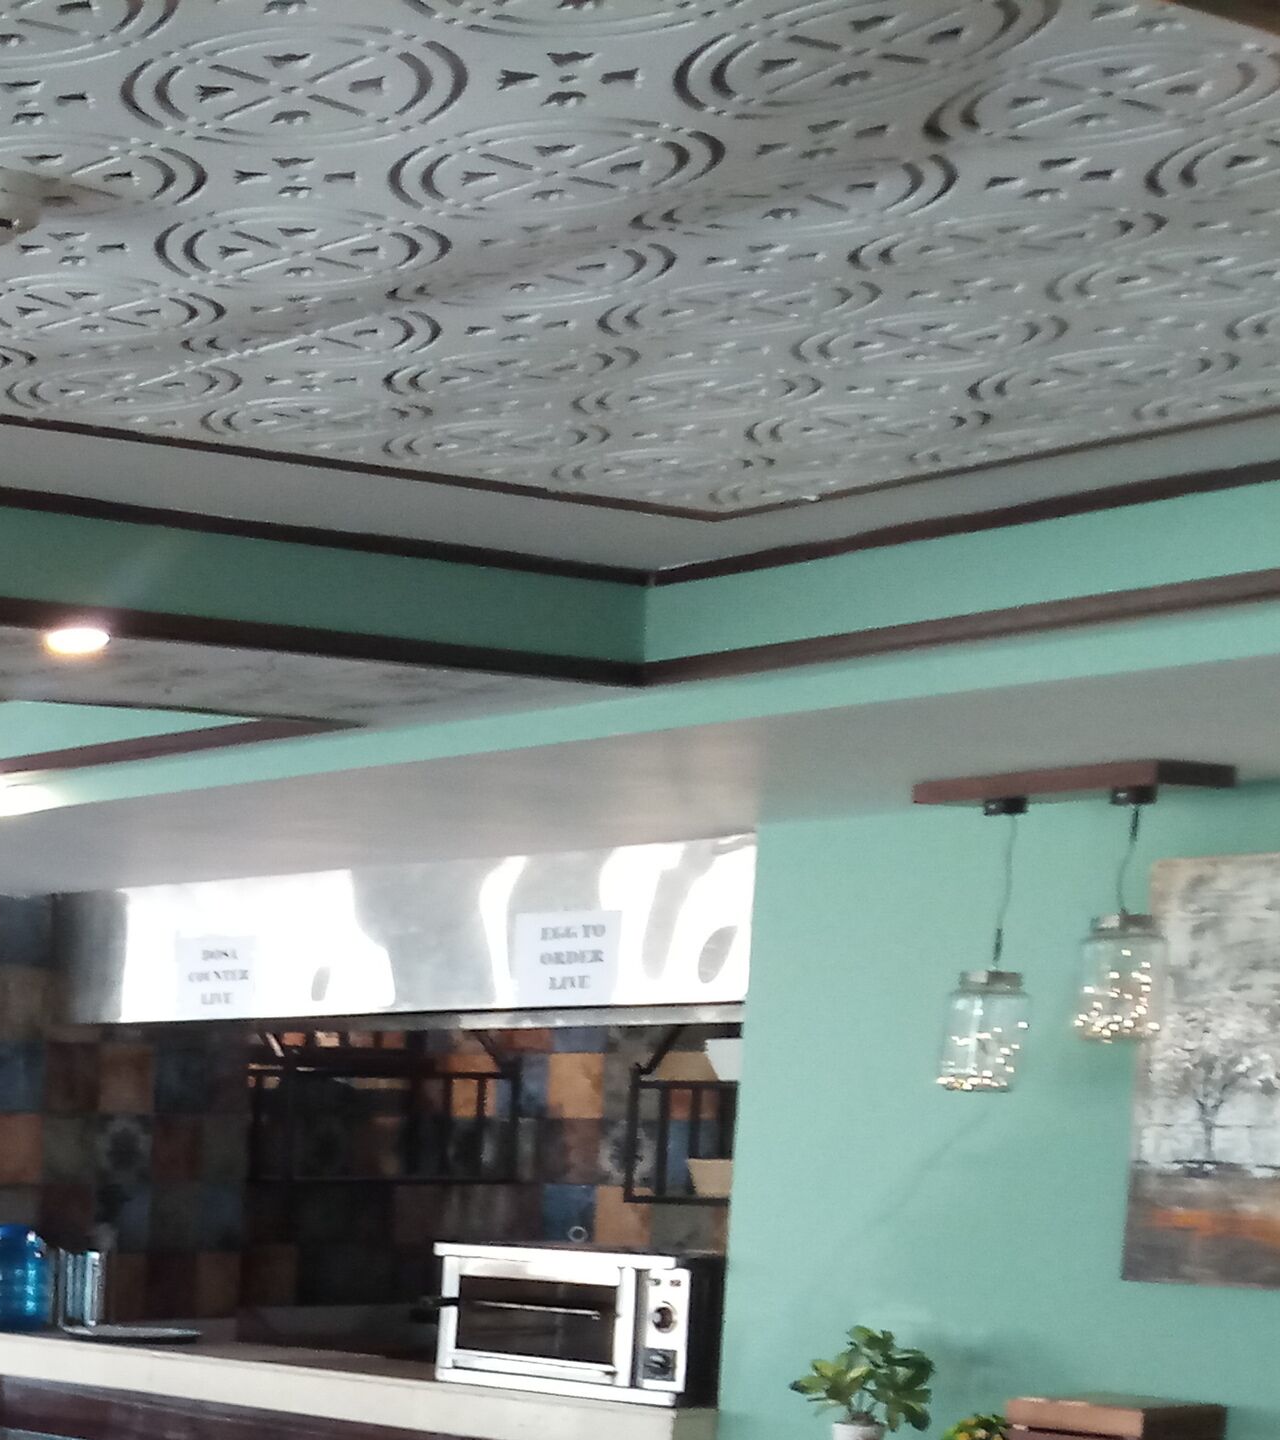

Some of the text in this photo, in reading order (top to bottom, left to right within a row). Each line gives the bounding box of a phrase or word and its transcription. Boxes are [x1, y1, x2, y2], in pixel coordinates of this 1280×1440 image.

[582, 923, 606, 938] TO
[539, 949, 604, 965] ORDER
[548, 974, 591, 990] LIVE
